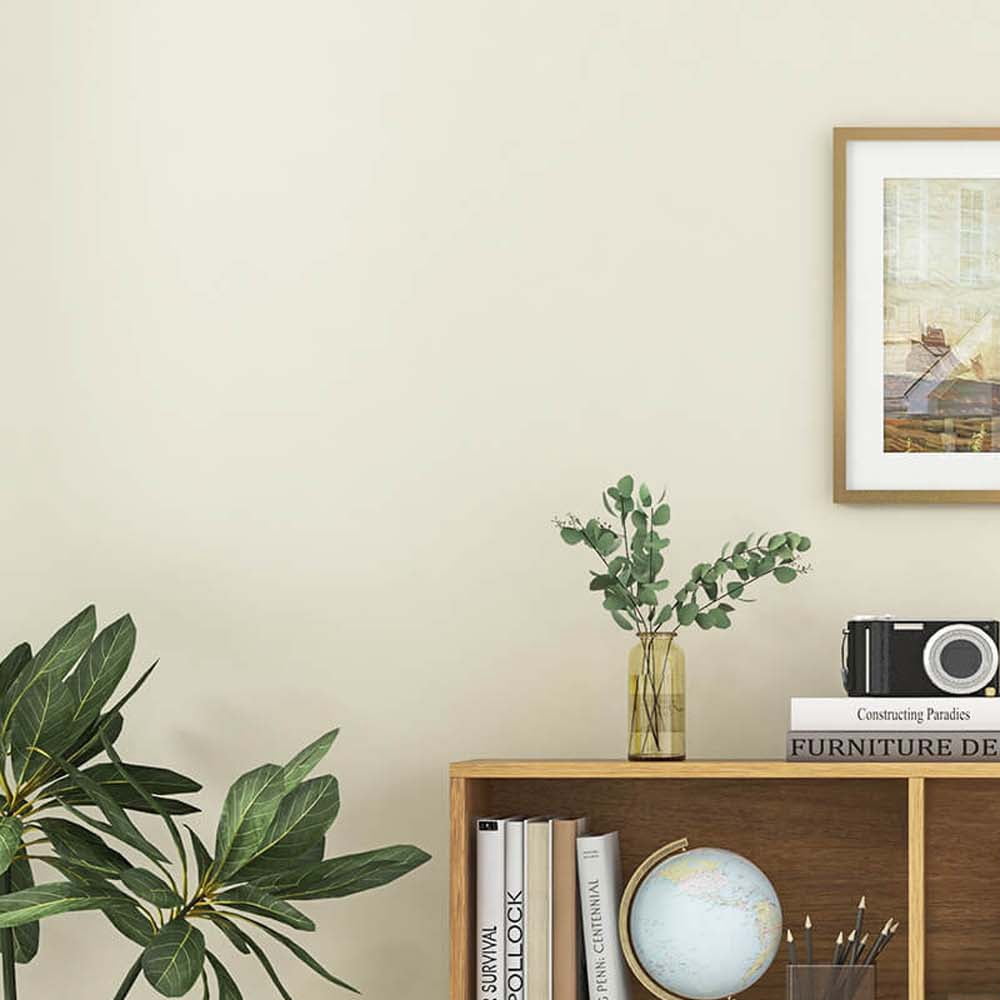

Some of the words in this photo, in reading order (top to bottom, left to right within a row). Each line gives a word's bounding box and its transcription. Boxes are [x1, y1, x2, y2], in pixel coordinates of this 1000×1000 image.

[856, 706, 924, 725] Constructing
[926, 706, 971, 722] Paradies
[791, 737, 951, 757] FURNITURE
[588, 879, 606, 953] CENTENNIAL
[481, 925, 497, 993] SURVIVAL
[594, 957, 609, 991] PENN:
